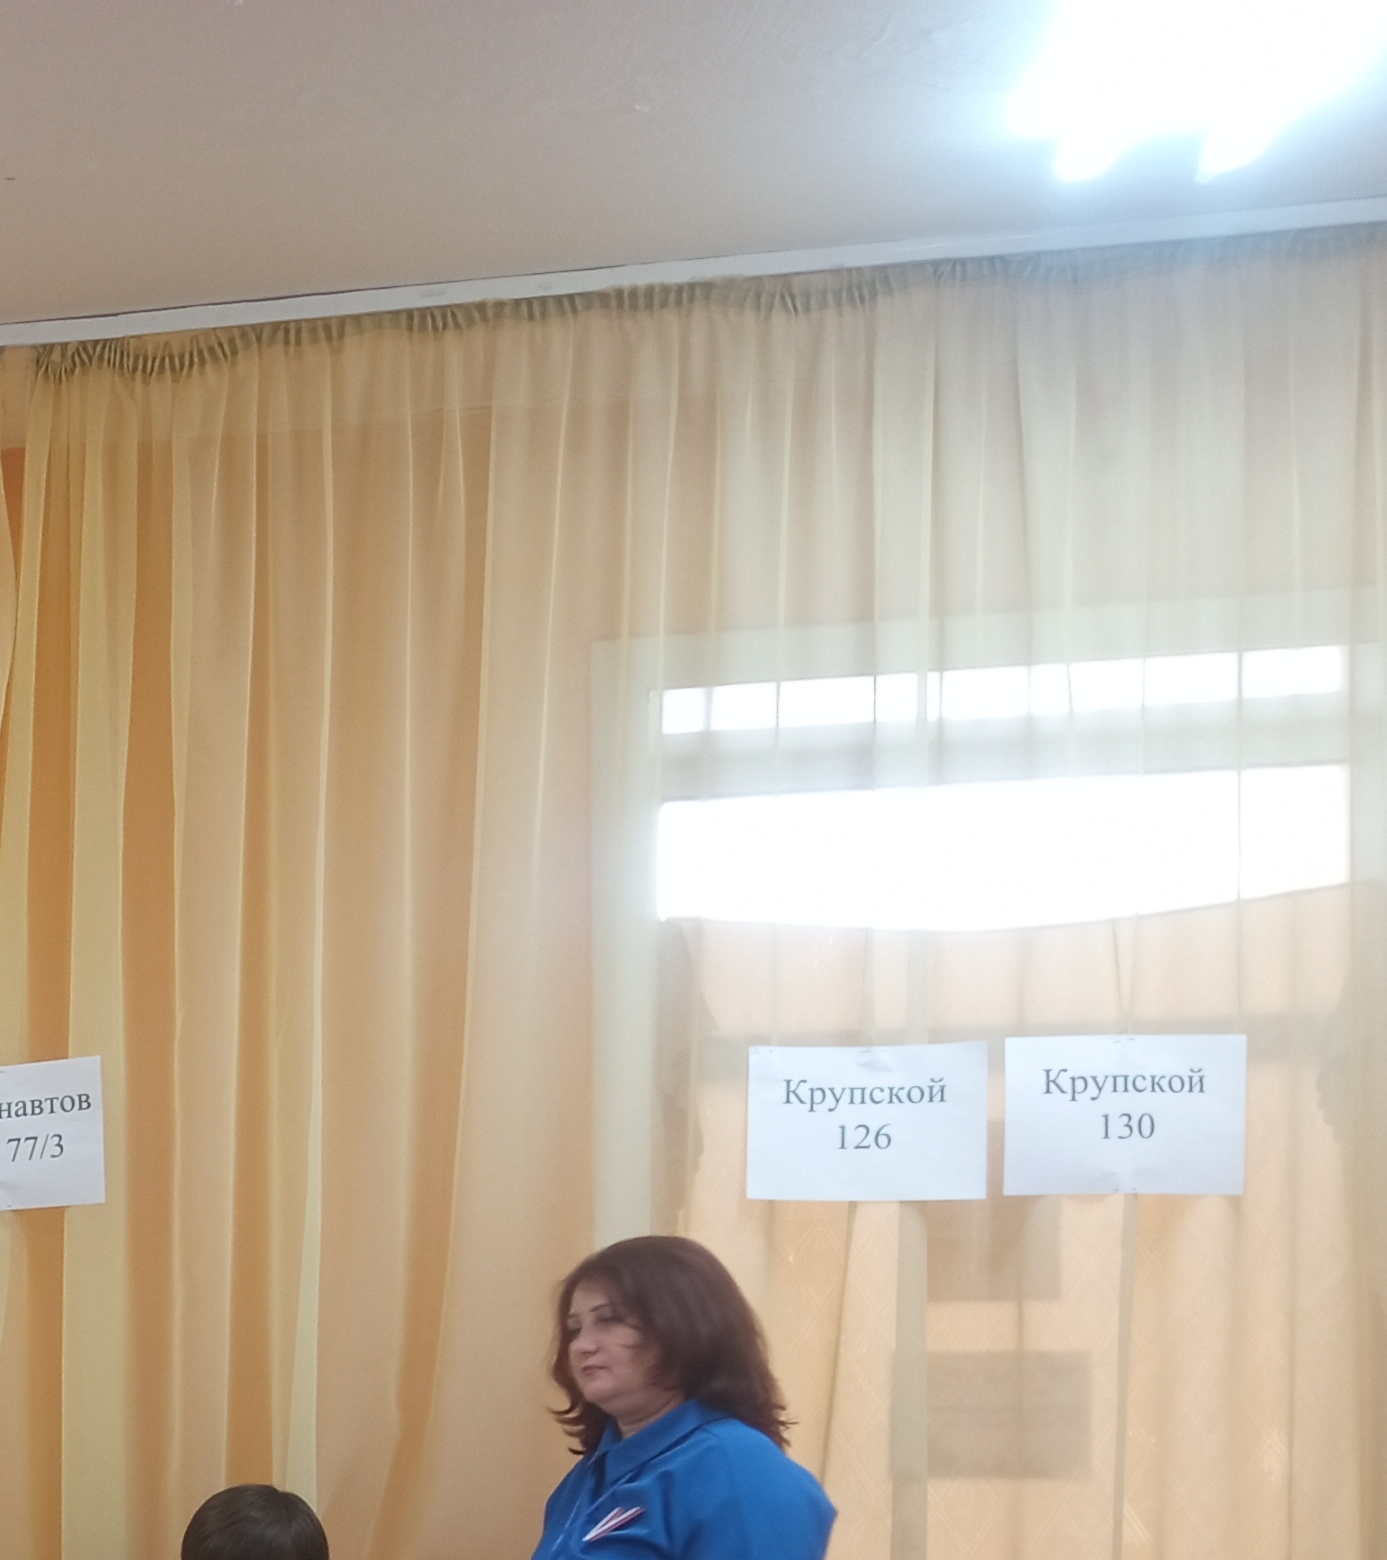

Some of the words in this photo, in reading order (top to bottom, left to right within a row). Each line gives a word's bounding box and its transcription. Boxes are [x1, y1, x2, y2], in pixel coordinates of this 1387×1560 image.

[783, 1078, 947, 1112] Крупской
[1043, 1068, 1205, 1100] Крупской
[837, 1124, 892, 1150] 126
[1101, 1112, 1155, 1140] 130
[7, 1133, 64, 1162] 77/3
